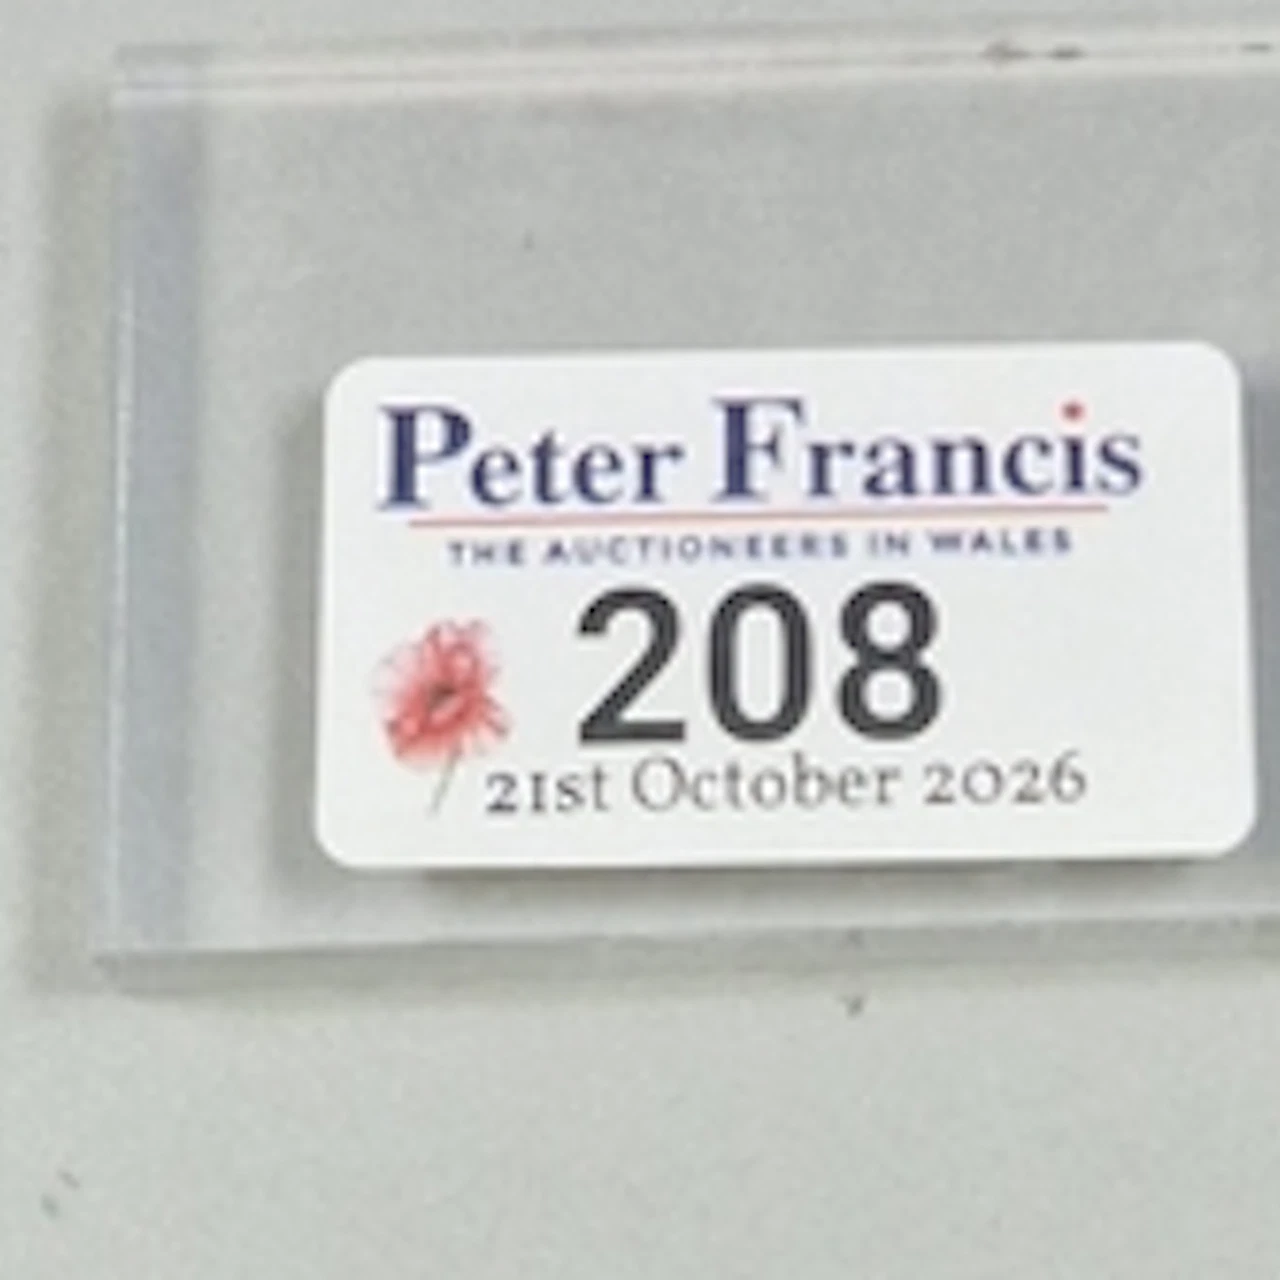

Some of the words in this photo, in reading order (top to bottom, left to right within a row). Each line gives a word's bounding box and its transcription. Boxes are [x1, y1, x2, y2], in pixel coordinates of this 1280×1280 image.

[379, 405, 687, 513] Peter
[713, 397, 1143, 501] Francis
[449, 539, 522, 566] THE
[544, 533, 848, 564] AUCTIONEERS
[868, 532, 910, 556] IN
[929, 527, 1072, 556] WALES
[575, 580, 943, 746] 208
[485, 765, 608, 814] 21st
[630, 751, 901, 811] October
[923, 750, 1087, 806] 2026
